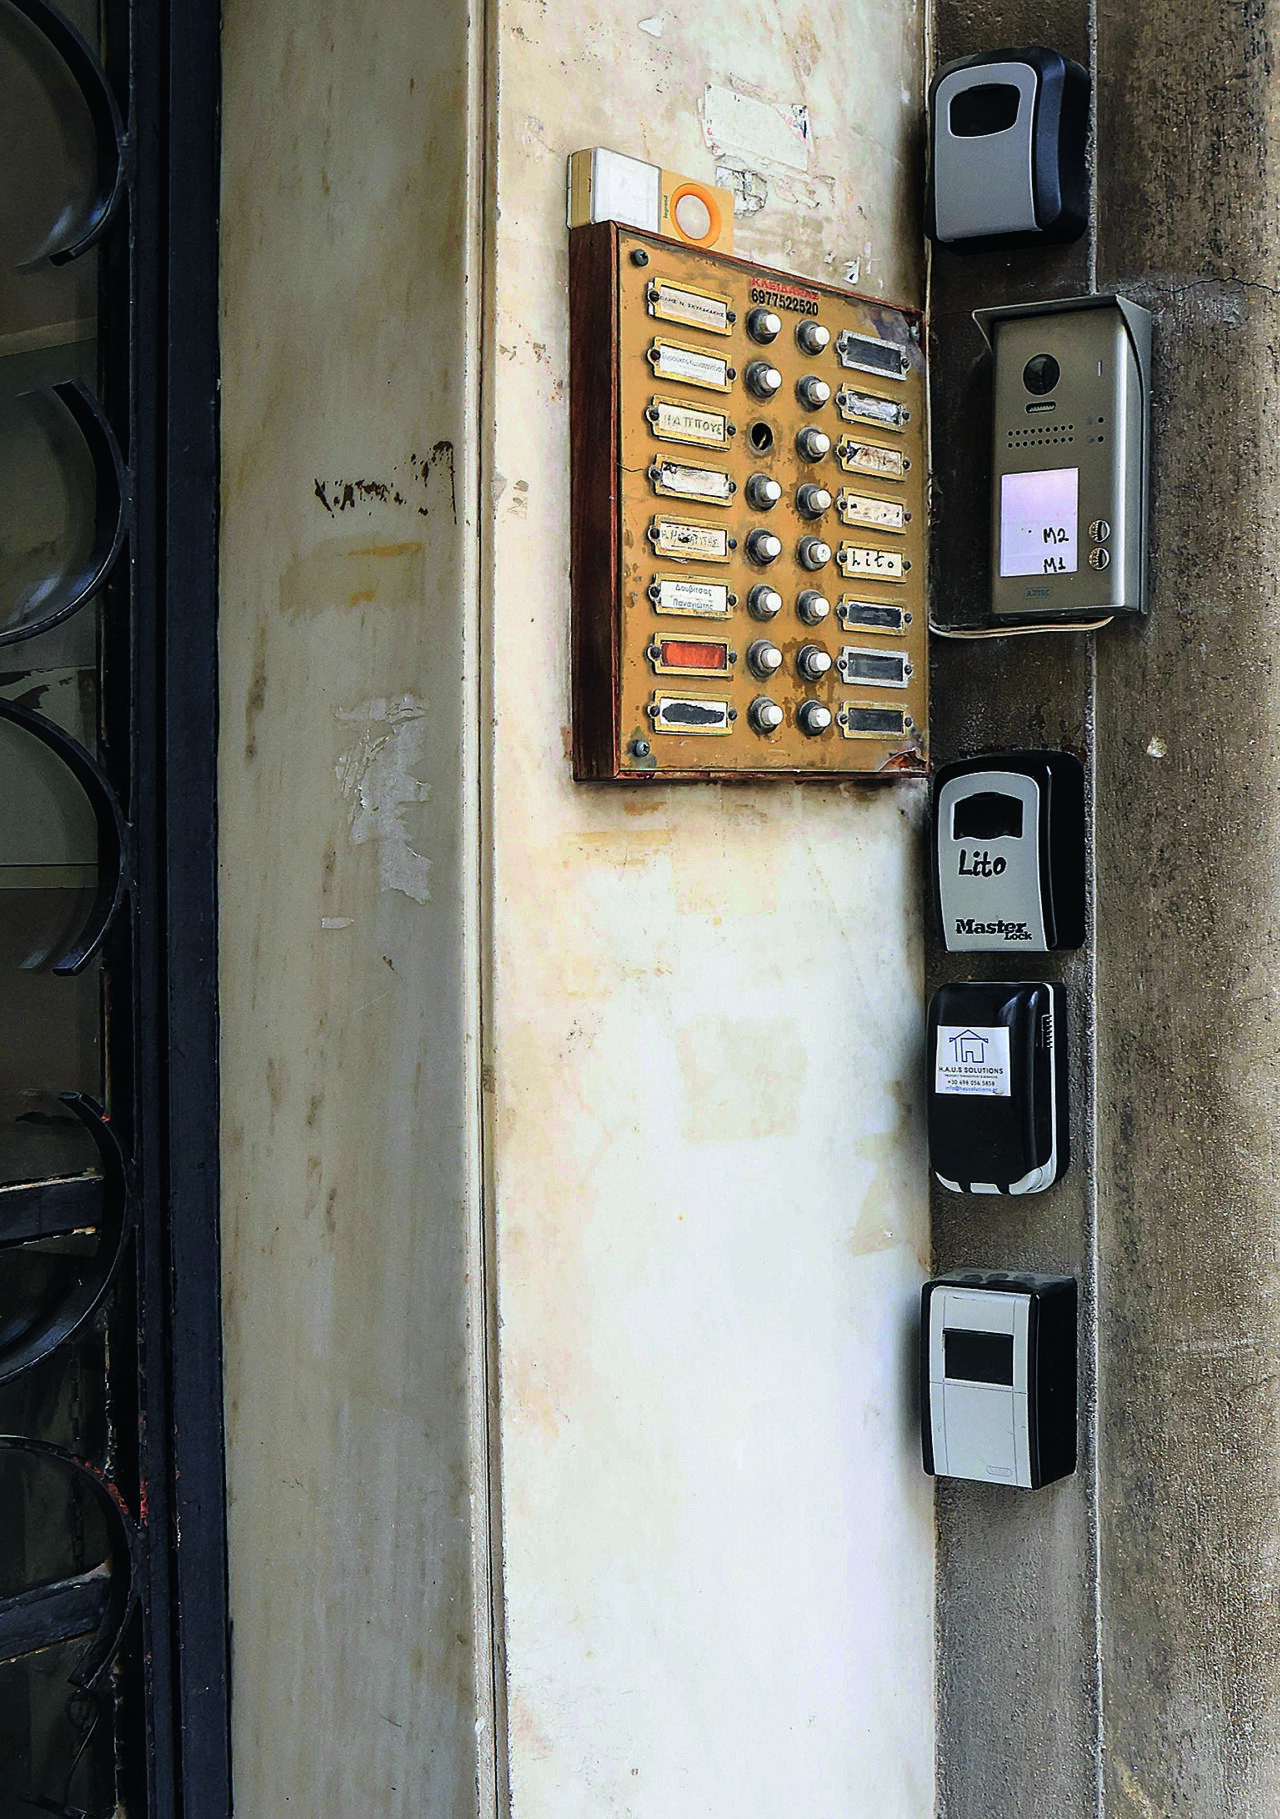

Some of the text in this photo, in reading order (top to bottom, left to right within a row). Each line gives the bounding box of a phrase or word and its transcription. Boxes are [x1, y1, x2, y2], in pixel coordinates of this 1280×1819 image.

[751, 287, 819, 317] 6977522520
[1043, 528, 1069, 544] M2
[1043, 557, 1066, 574] M1
[958, 849, 1007, 877] Lito
[955, 918, 1027, 935] Master
[1004, 930, 1033, 941] Lock
[964, 1066, 1004, 1075] SOLUTIONS
